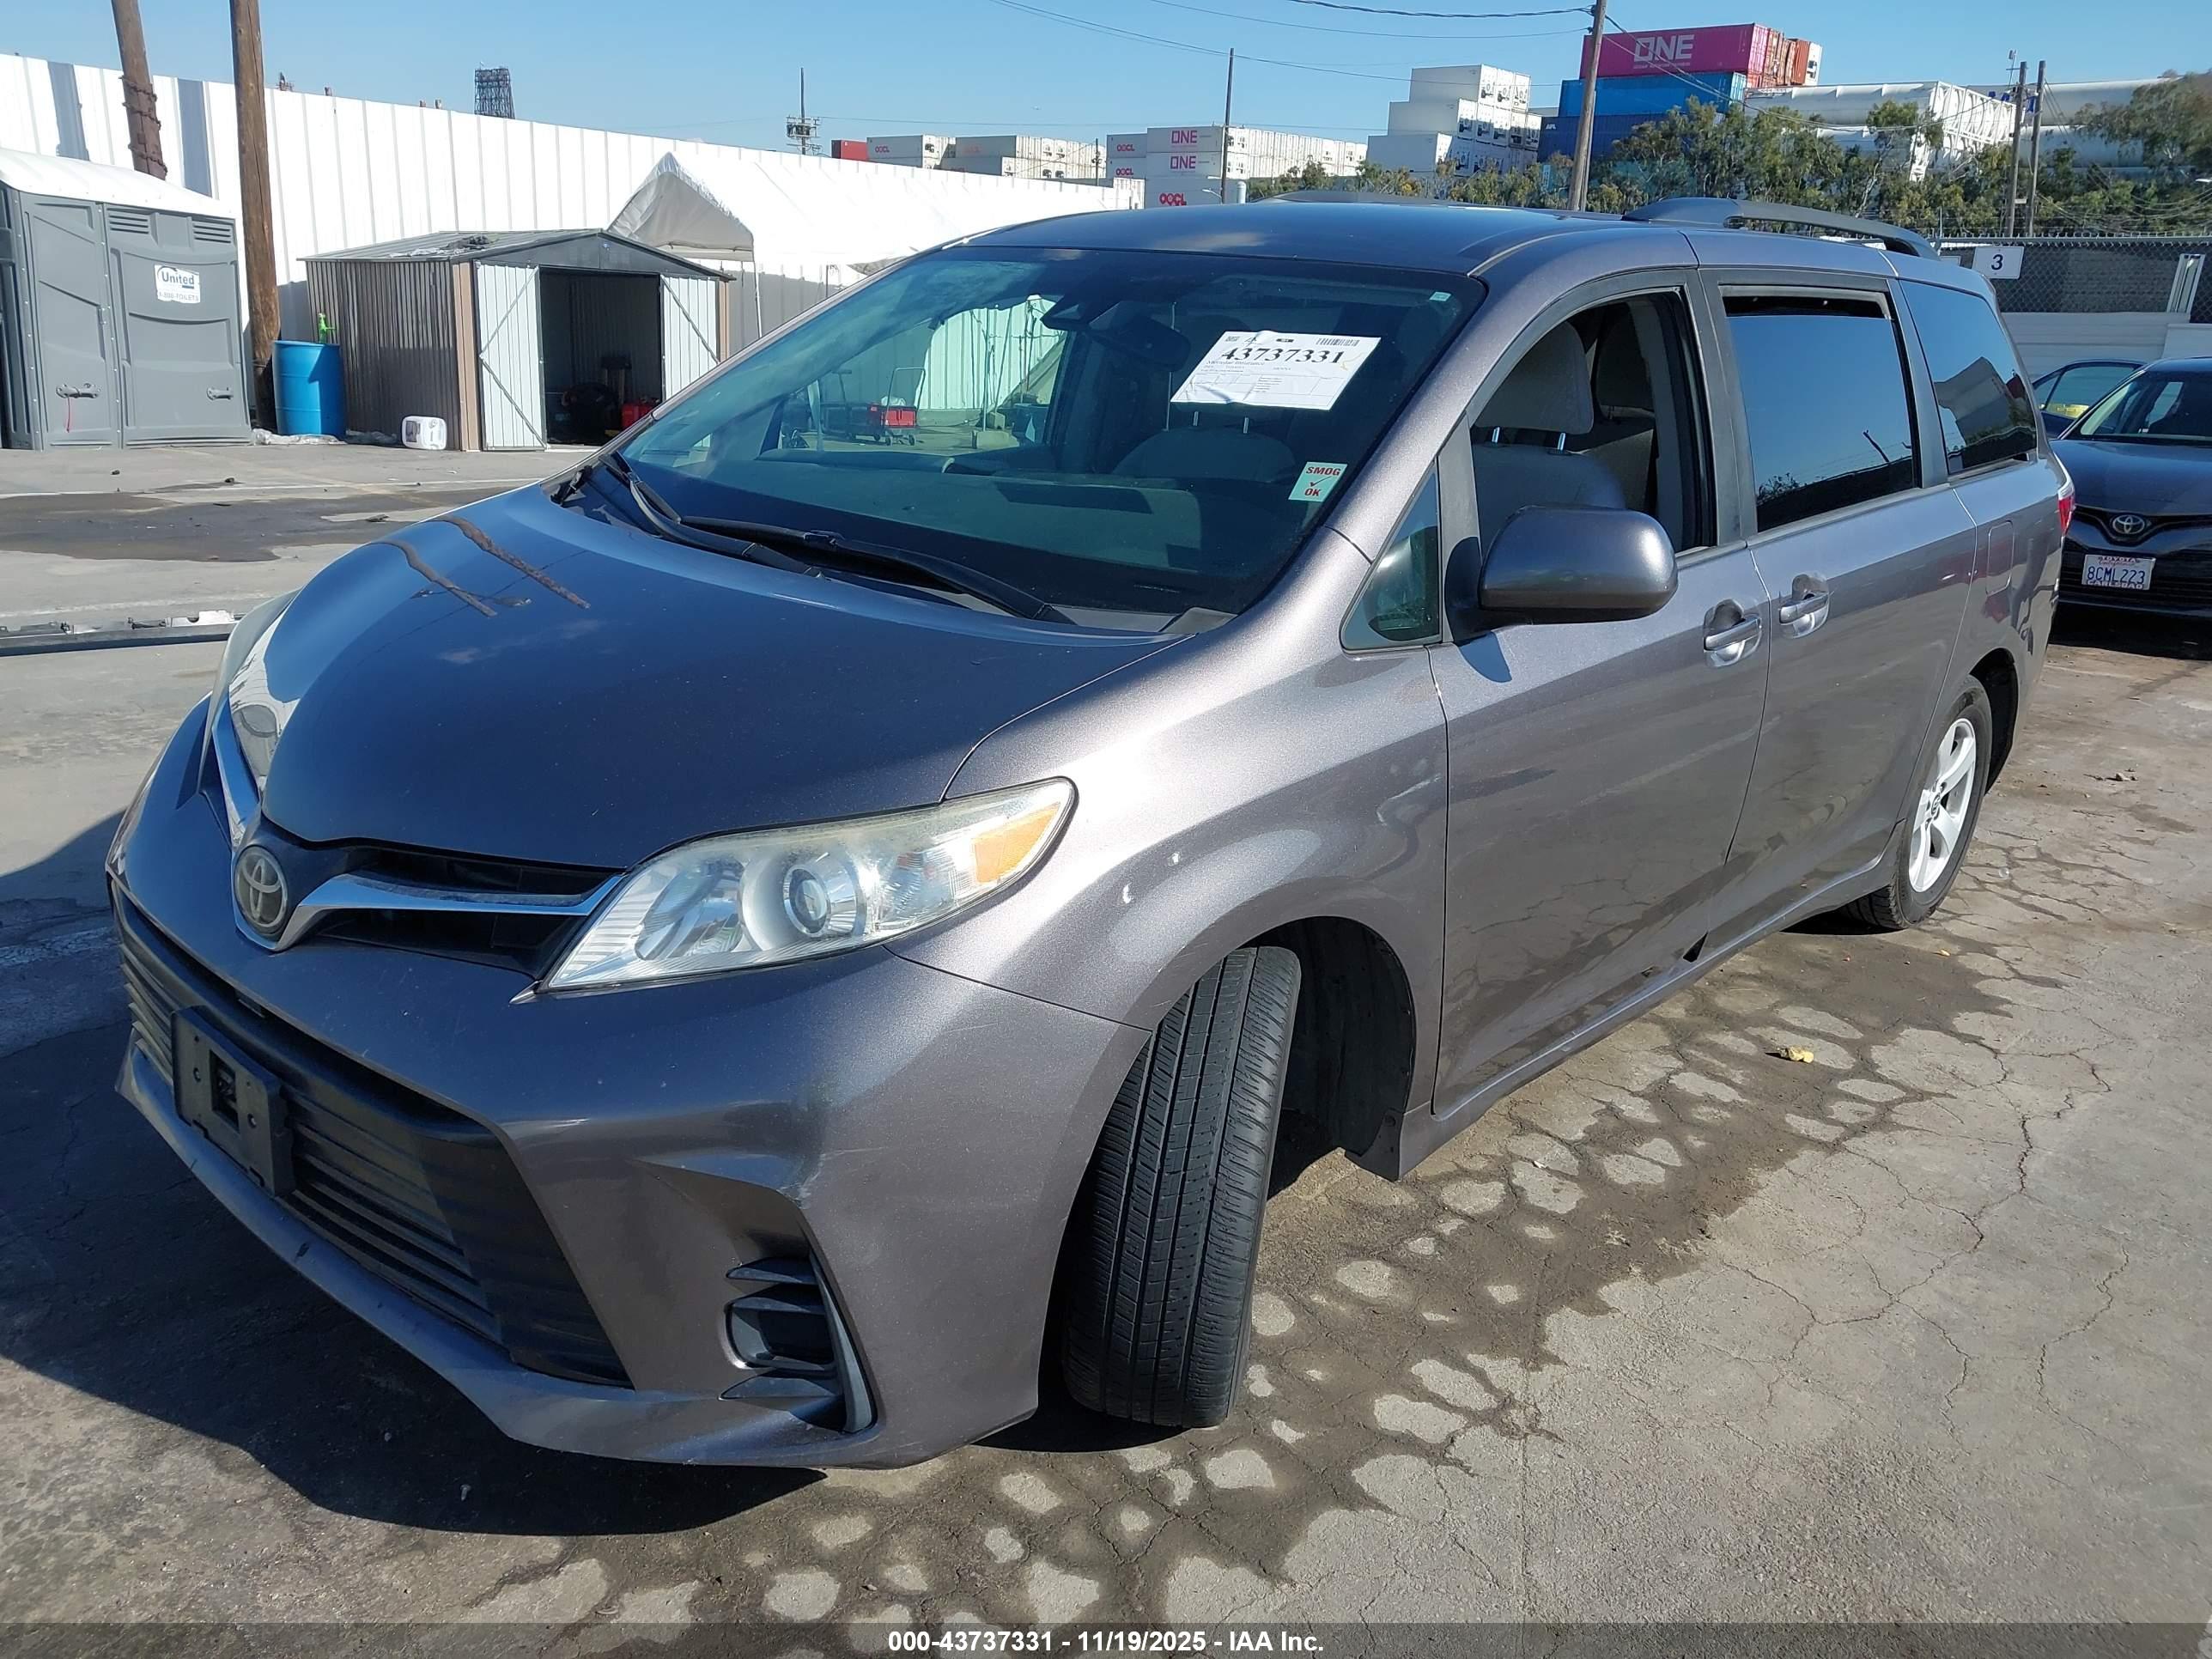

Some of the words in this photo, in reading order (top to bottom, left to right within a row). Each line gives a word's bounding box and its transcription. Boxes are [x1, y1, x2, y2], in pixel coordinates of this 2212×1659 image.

[1634, 34, 1694, 63] ONE
[1171, 130, 1198, 143] ONE
[1170, 155, 1196, 169] ONE
[1115, 167, 1134, 176] OOCL
[1159, 192, 1187, 206] OOCL
[1990, 253, 2003, 270] 3
[161, 271, 194, 284] United
[1221, 347, 1345, 363] 43737331
[1306, 466, 1341, 476] SMOG
[1304, 488, 1321, 496] OK
[2087, 566, 2145, 584] 8CML223
